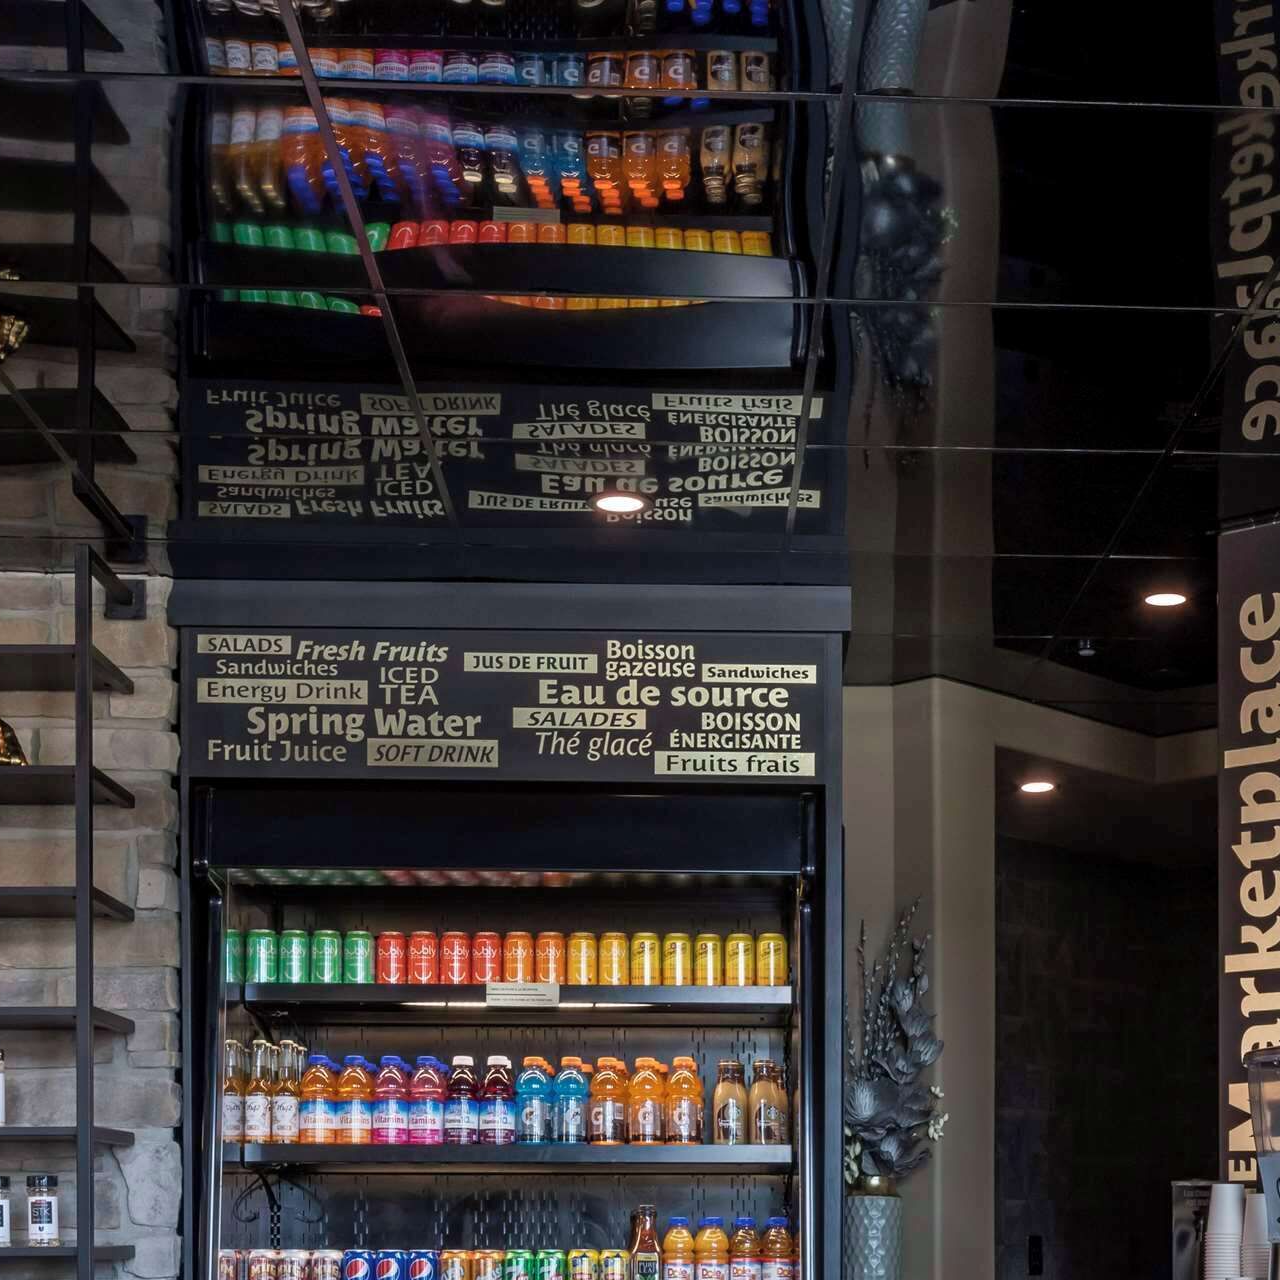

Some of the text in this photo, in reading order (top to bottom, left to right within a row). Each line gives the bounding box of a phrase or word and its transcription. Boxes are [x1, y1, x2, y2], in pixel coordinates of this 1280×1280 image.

[207, 637, 283, 653] SALADS
[296, 640, 449, 663] Fresh Fruits
[606, 639, 696, 661] Boisson
[215, 659, 339, 676] Sandwiches
[473, 655, 589, 671] JUS DE FRUIT
[605, 660, 696, 681] gazeuse
[707, 666, 810, 681] Sandwiches
[379, 667, 440, 684] ICED
[207, 681, 363, 702] Energy Drink
[378, 684, 440, 705] TEA
[538, 679, 790, 708] Eau de source
[247, 706, 482, 743] Spring Water
[527, 711, 639, 728] SALADES
[701, 712, 801, 731] BOISSON
[535, 731, 653, 761] Thé glacé
[669, 729, 802, 750] ÉNERGISANTE
[207, 740, 348, 763] Fruit Juice
[373, 744, 495, 763] SOFT DRINK
[666, 755, 801, 774] Fruits frais
